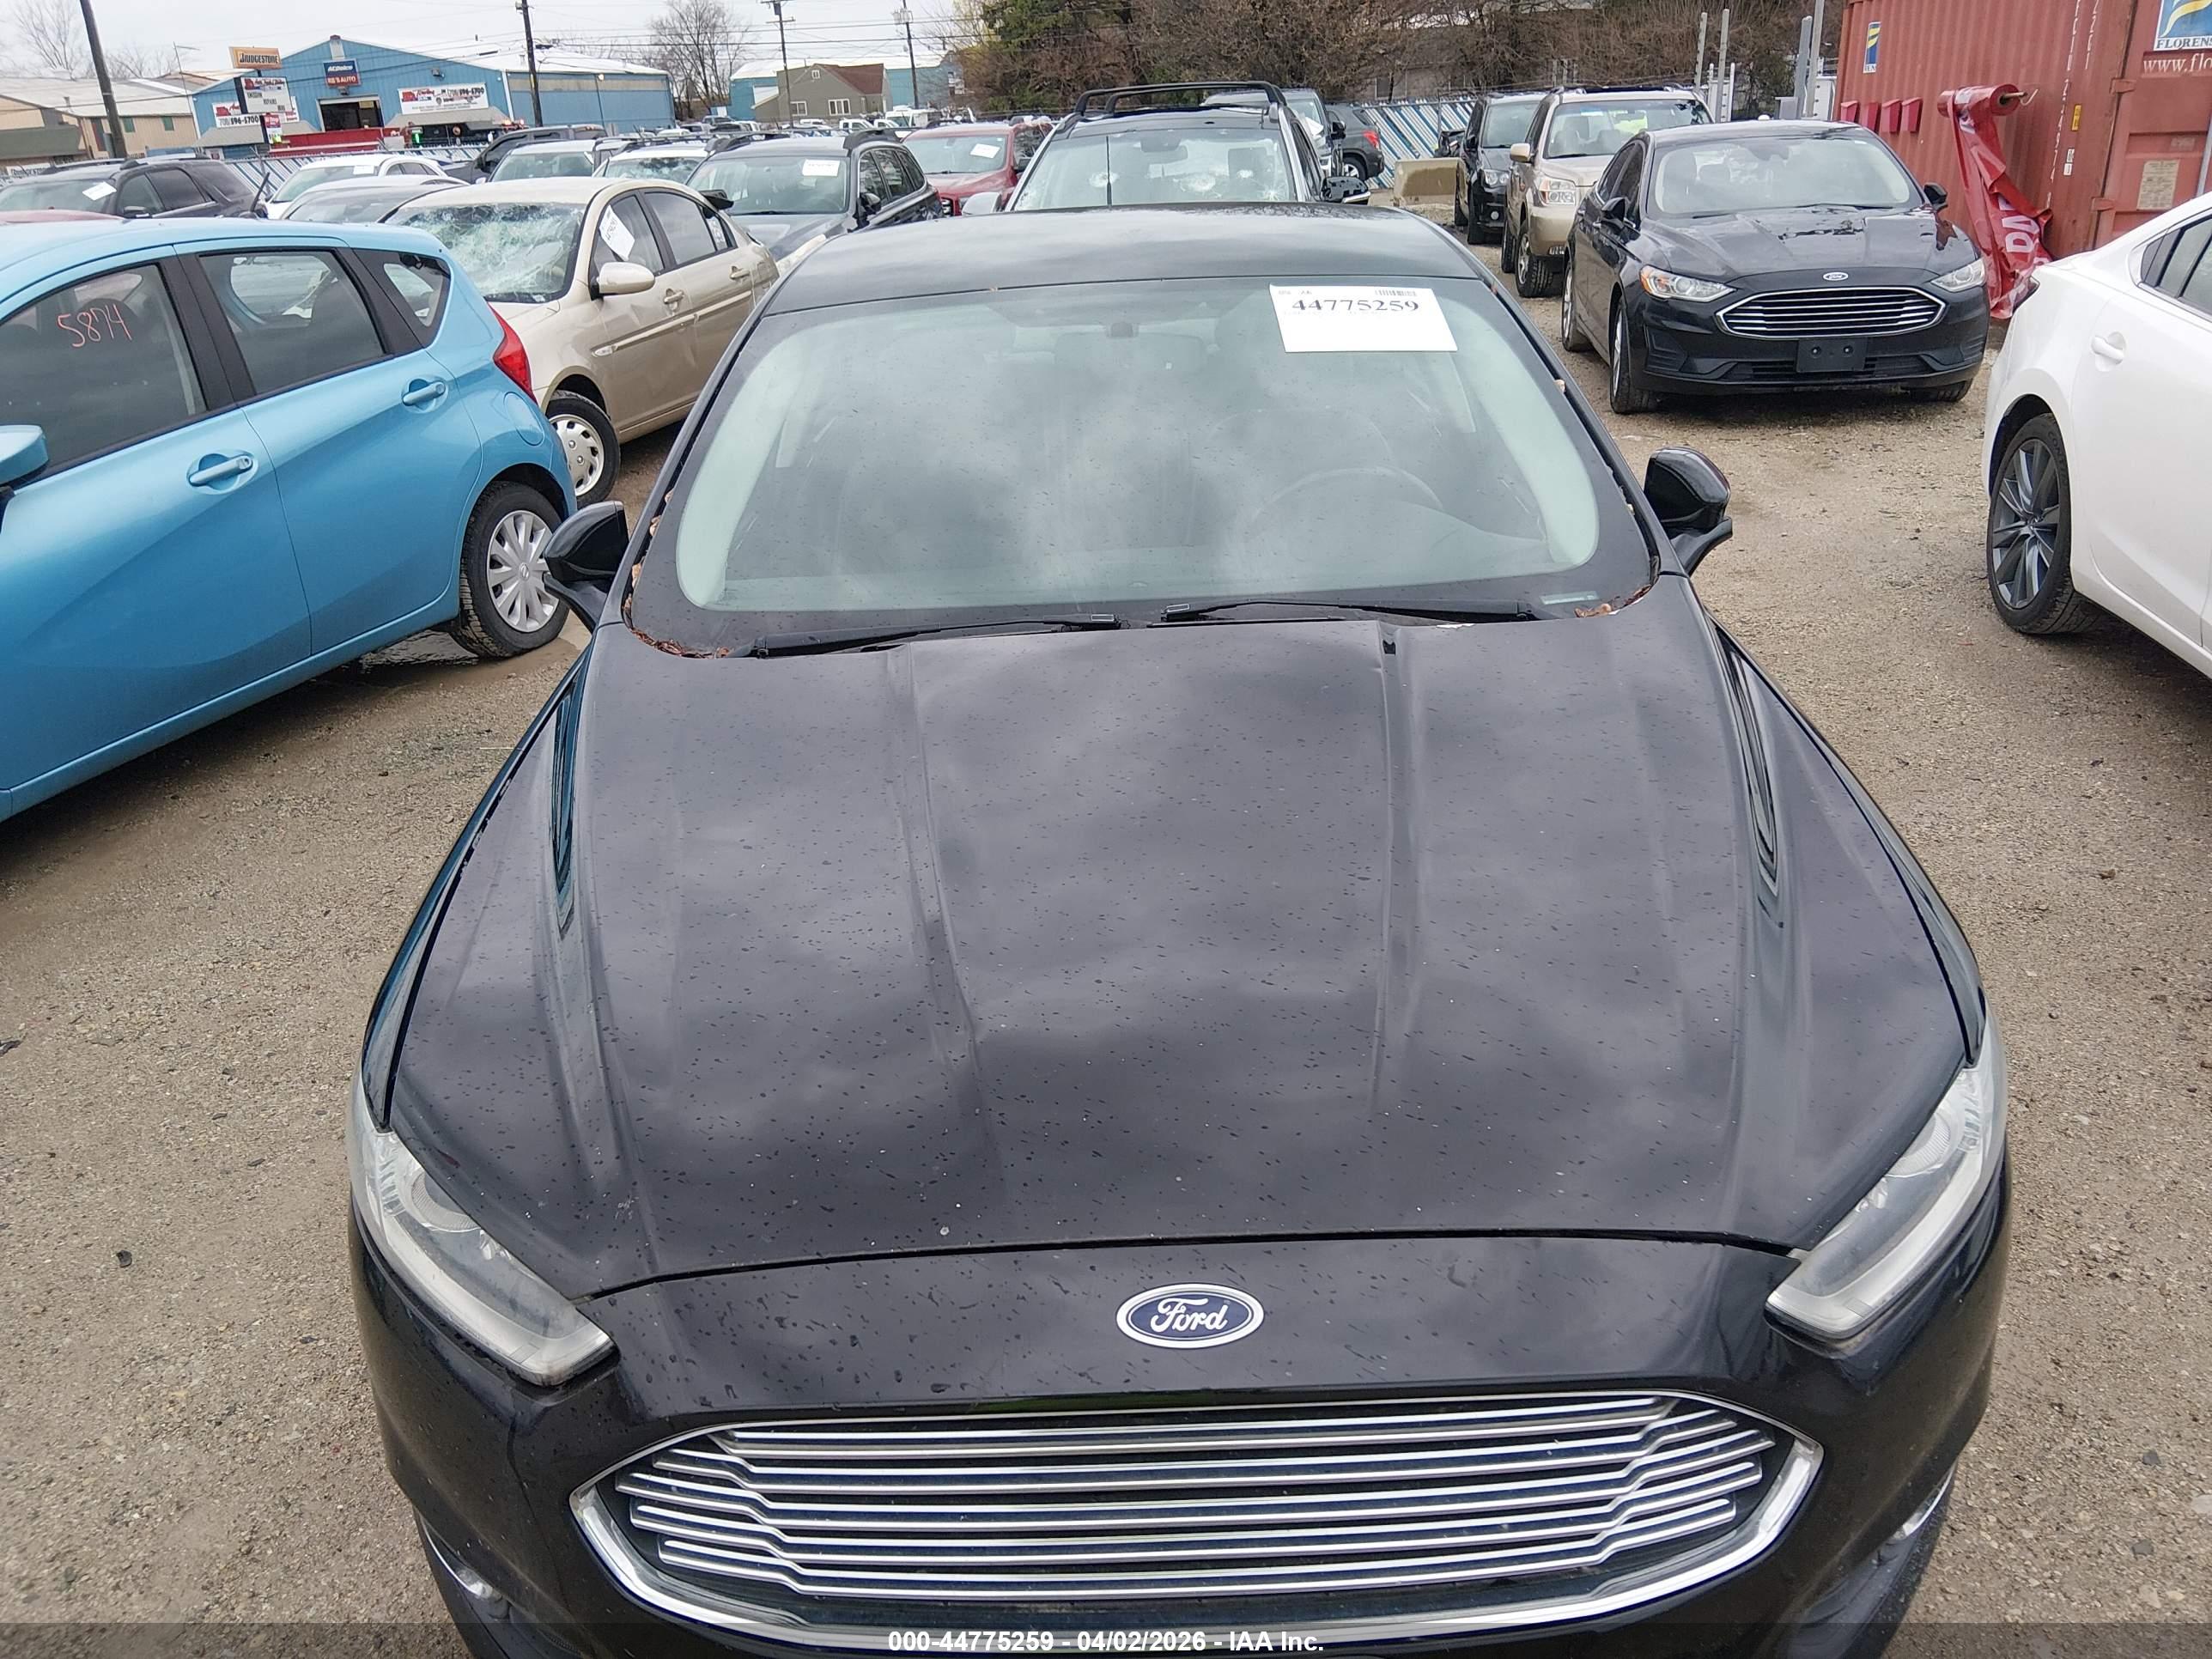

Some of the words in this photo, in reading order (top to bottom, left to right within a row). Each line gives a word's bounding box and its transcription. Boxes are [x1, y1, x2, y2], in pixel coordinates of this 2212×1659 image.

[240, 53, 279, 64] BRIDGESTONE
[1291, 299, 1419, 312] 44775259
[58, 303, 132, 348] 5874
[1150, 1297, 1229, 1333] Ford
